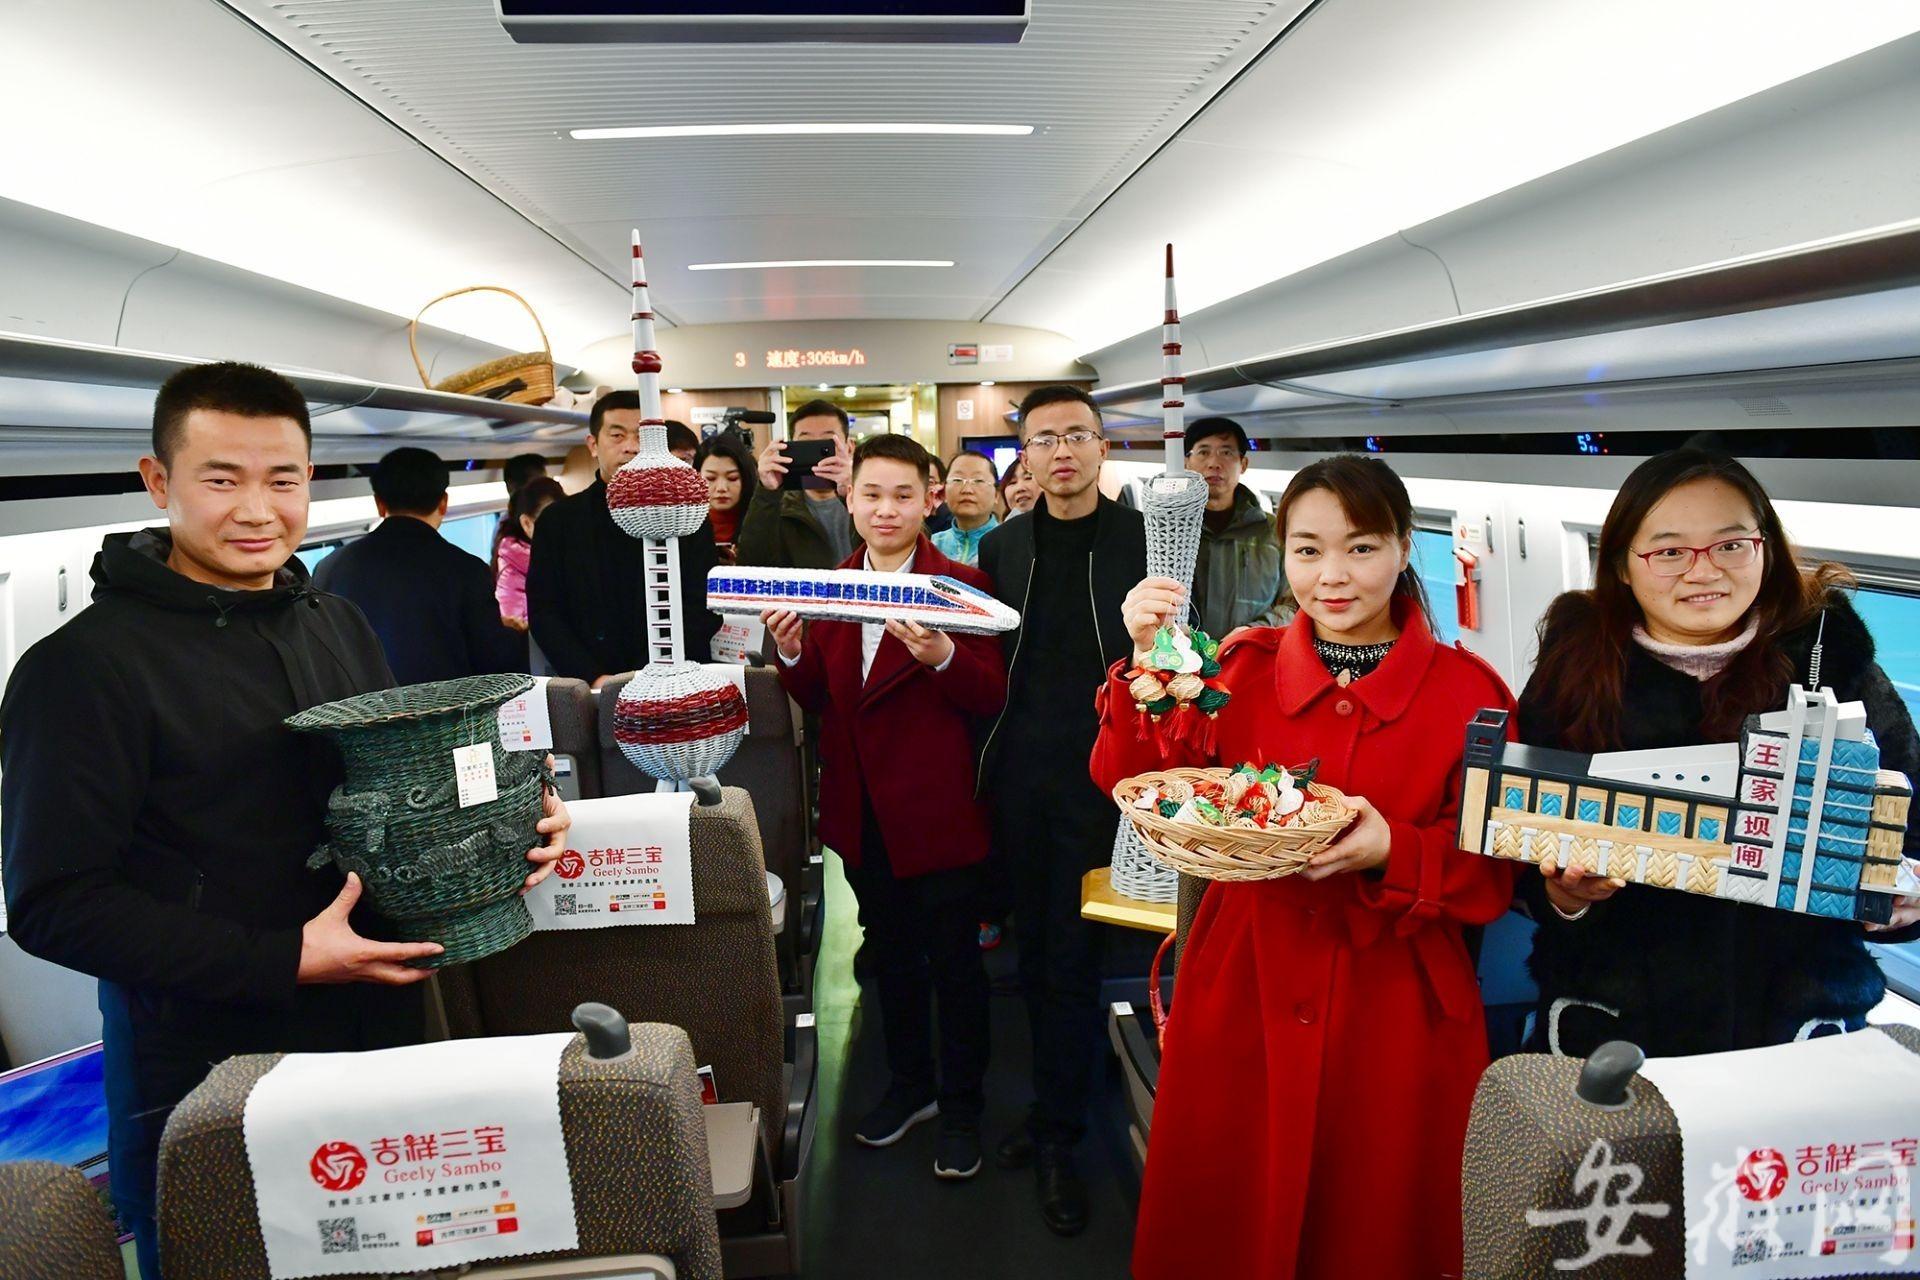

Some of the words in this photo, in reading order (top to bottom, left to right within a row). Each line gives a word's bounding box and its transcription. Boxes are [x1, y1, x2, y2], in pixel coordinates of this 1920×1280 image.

[735, 351, 746, 368] 3
[766, 348, 866, 368] 速度:306km/h
[1736, 743, 1782, 869] 王家坝闸
[587, 846, 663, 867] 吉祥三宝
[593, 867, 623, 878] Geely
[625, 865, 659, 876] Sambo
[370, 1126, 506, 1166] 吉祥三宝
[1795, 1138, 1918, 1177] 吉祥三宝
[384, 1165, 437, 1184] Geely
[441, 1159, 502, 1178] Sambo
[1801, 1177, 1850, 1196] Geely
